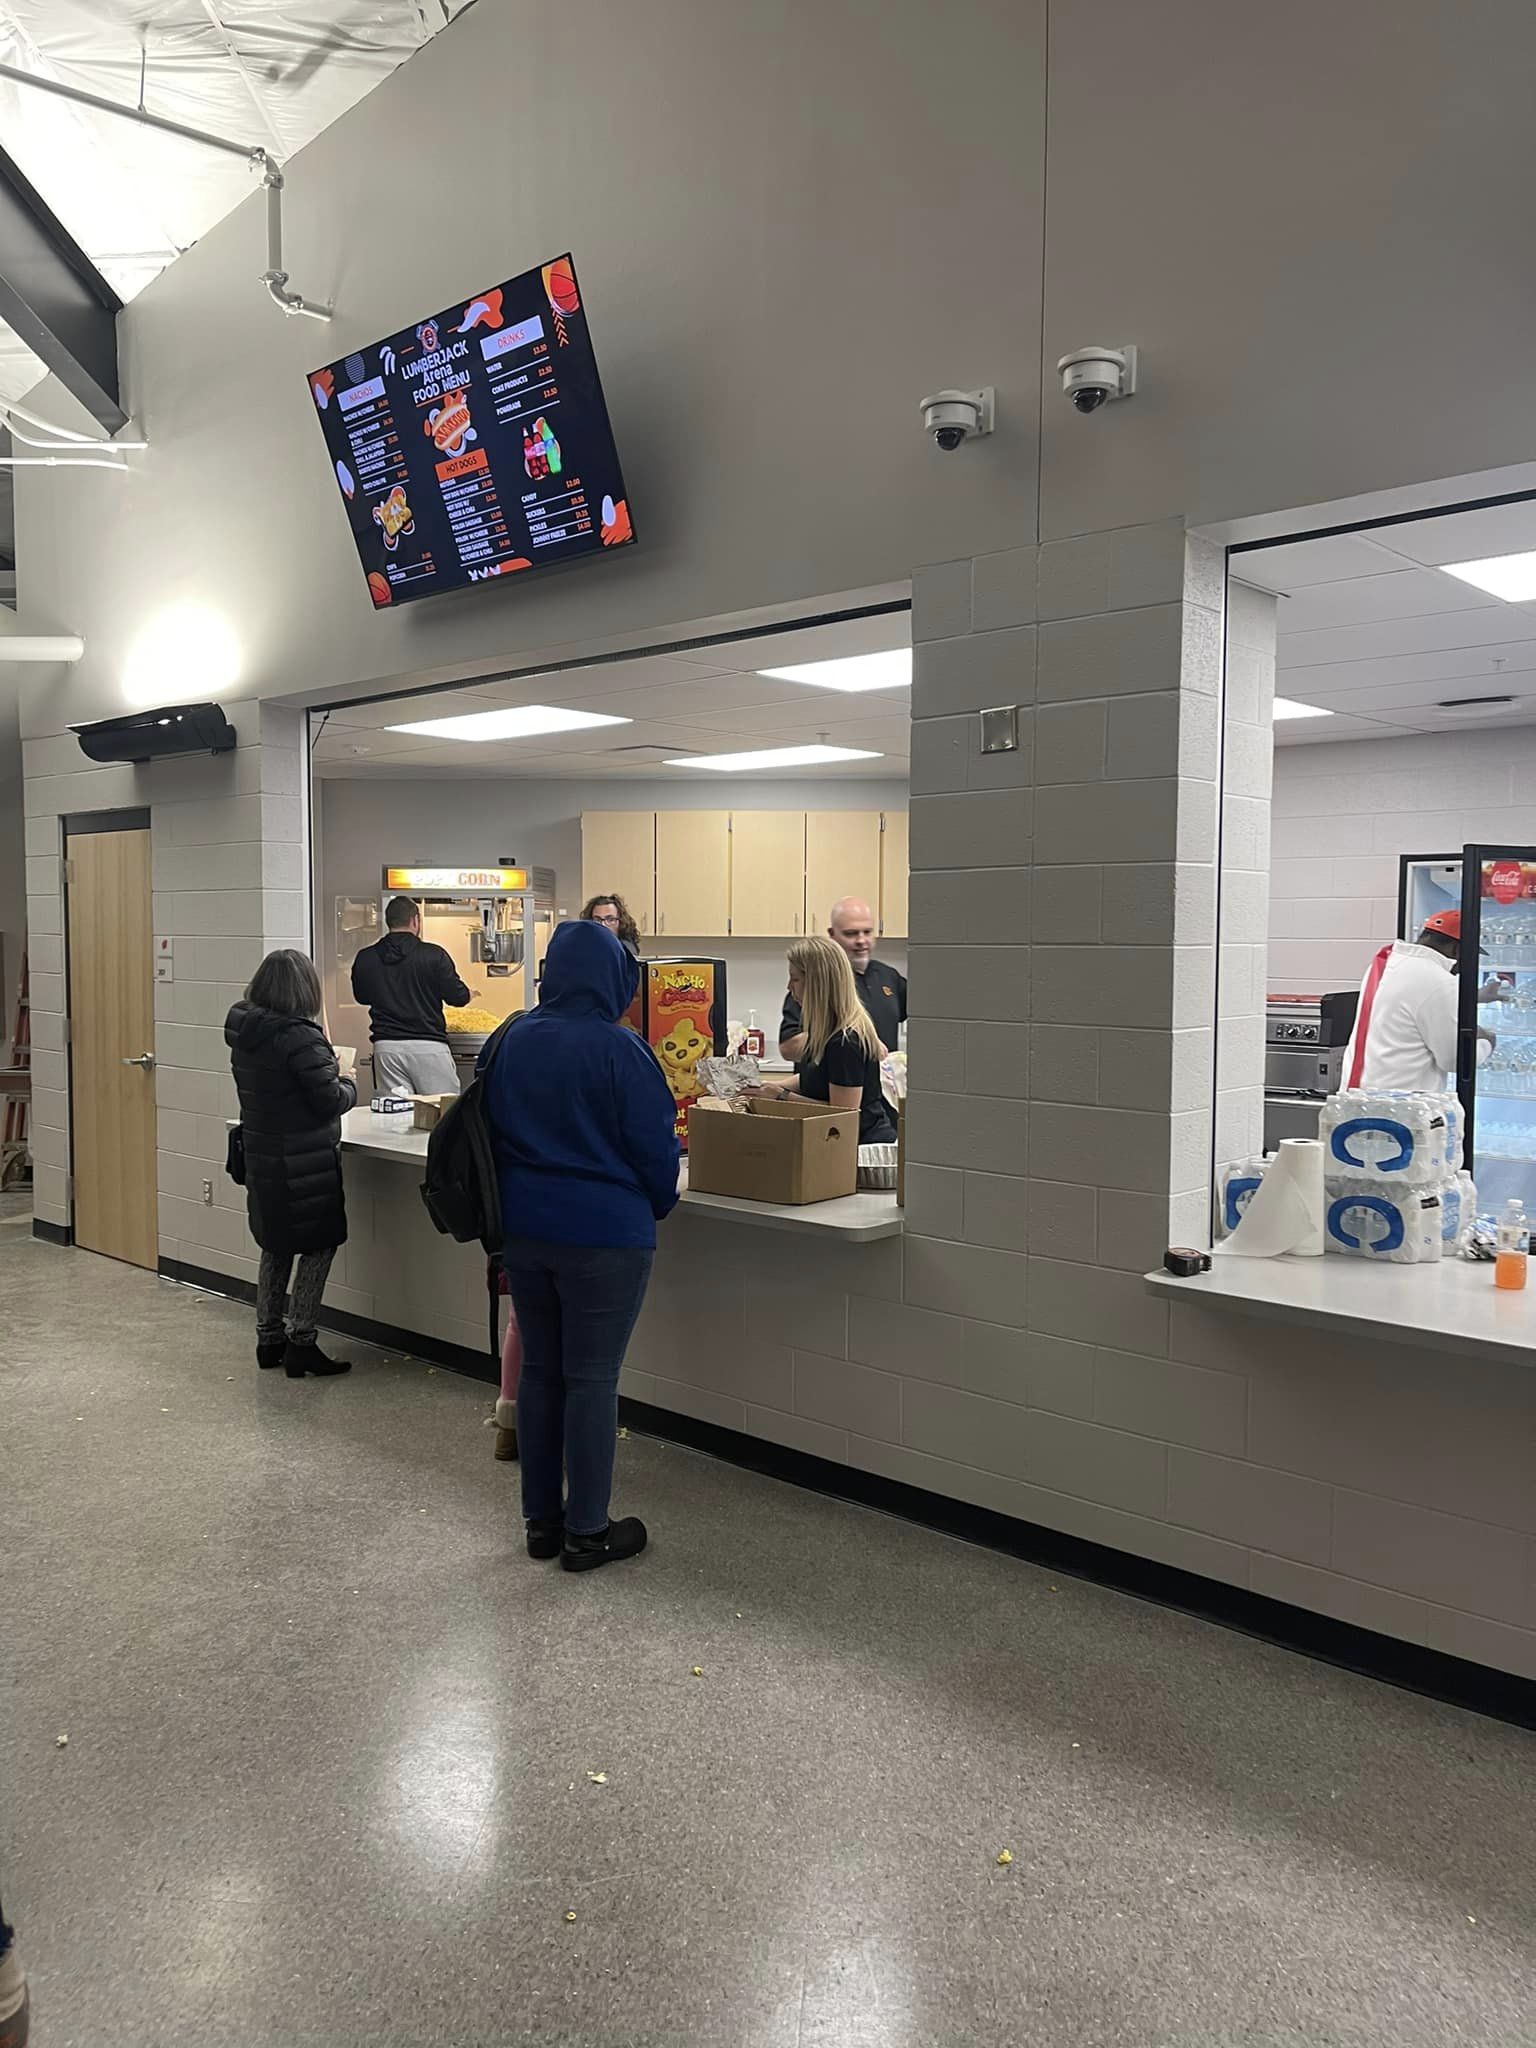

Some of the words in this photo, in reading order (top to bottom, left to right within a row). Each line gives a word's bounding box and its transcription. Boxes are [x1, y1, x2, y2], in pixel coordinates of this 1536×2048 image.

[498, 329, 525, 348] DRINKS
[402, 340, 468, 379] LUMBERJACK
[422, 362, 452, 385] Arena
[504, 375, 527, 389] PRODUCTS
[413, 383, 440, 403] FOOD
[442, 370, 470, 391] MENU
[446, 462, 459, 473] HOT
[459, 456, 476, 468] DOGS
[458, 872, 501, 887] CORN
